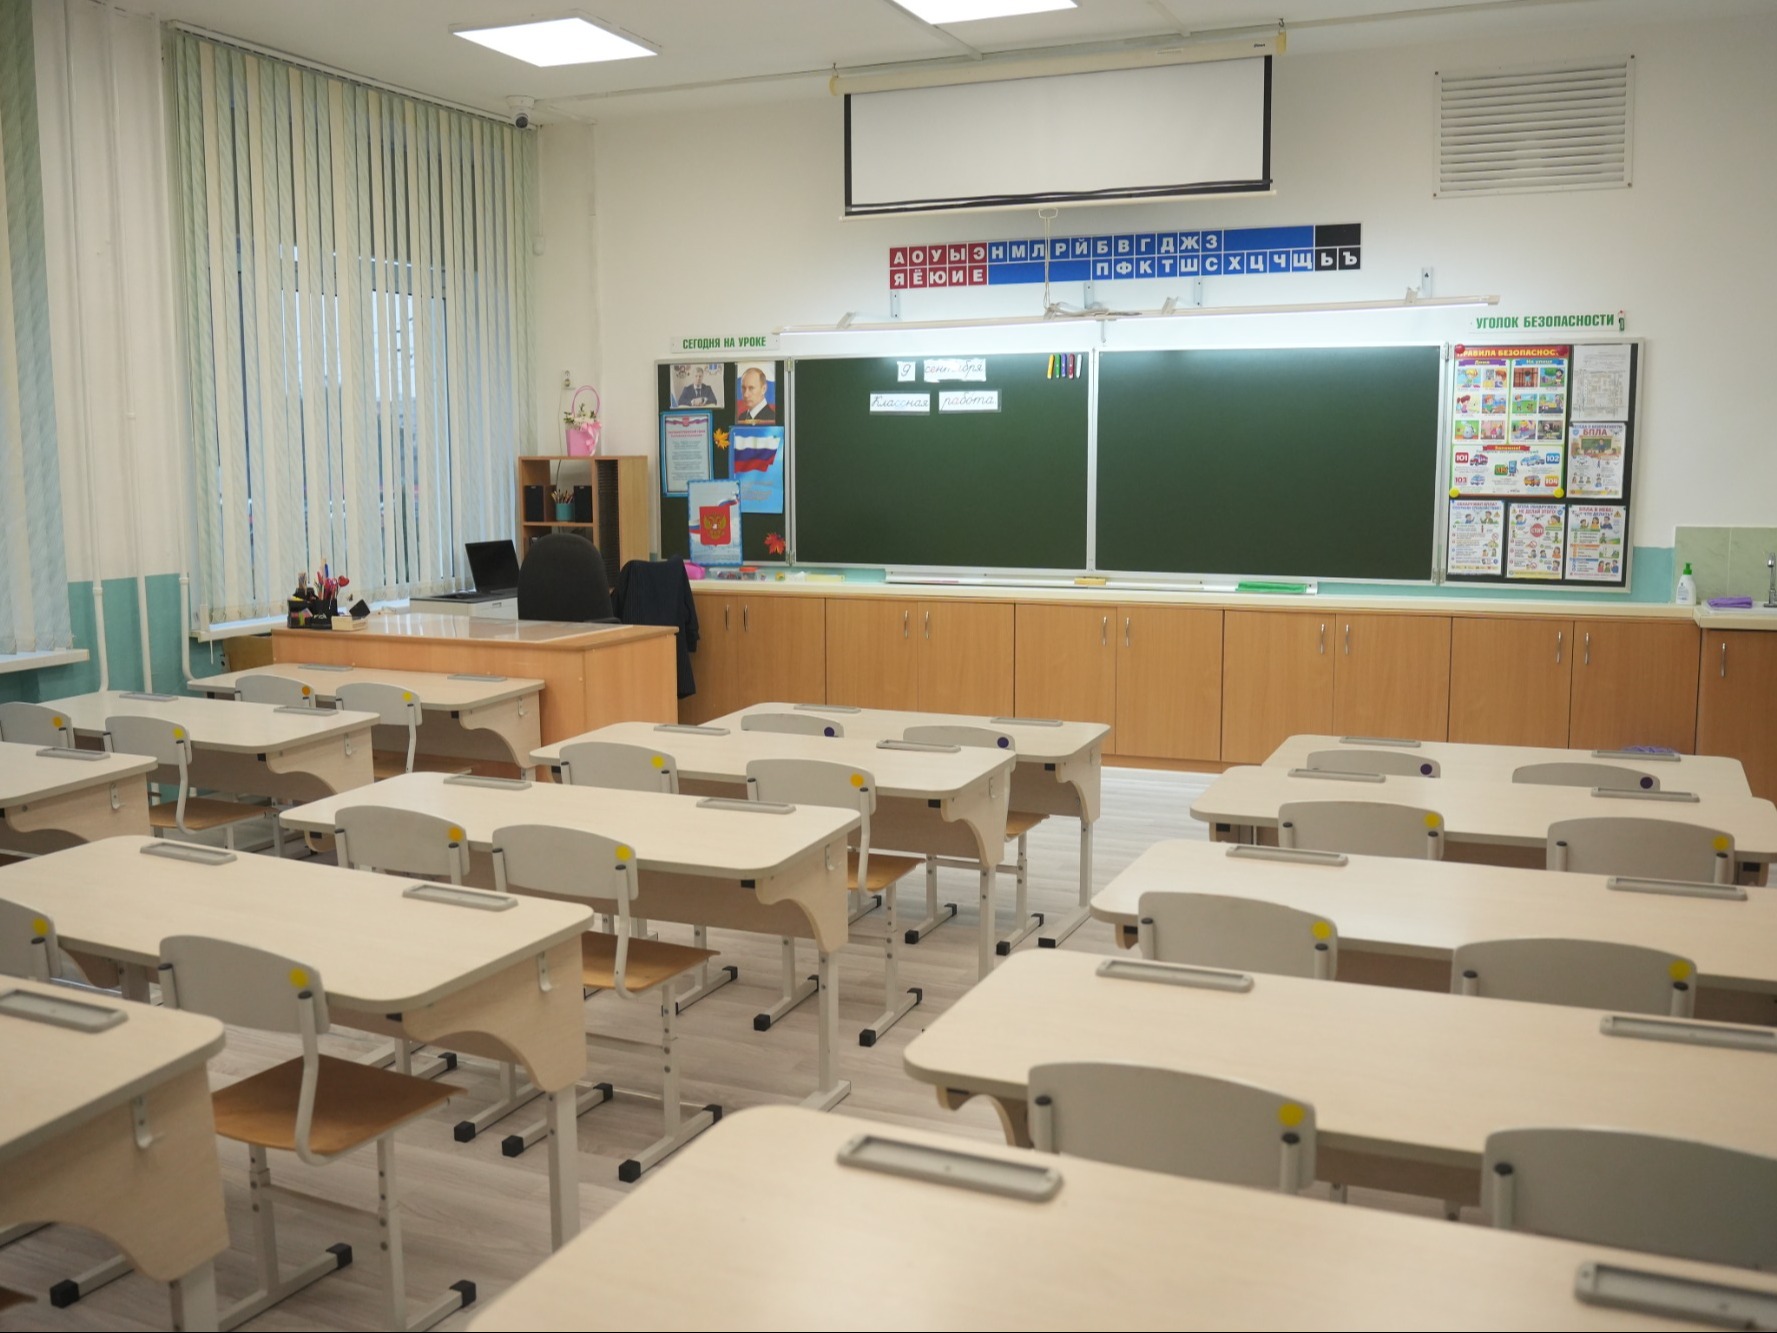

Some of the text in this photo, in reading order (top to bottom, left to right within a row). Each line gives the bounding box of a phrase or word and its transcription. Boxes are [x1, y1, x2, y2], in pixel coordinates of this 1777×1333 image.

[894, 235, 1217, 264] А О У Ы Э Н М Л Р Й Б В Г Д Ж З
[894, 252, 1357, 285] Я Ё Ю И Е П Ф К Т Ш С Х Ц Ч Щ Ь Ъ
[1476, 314, 1614, 329] УГОЛОК БЕЗОПАСНОСТИ
[682, 336, 767, 350] СЕГОДНЯ НА УРОКЕ
[900, 364, 912, 377] 9
[871, 394, 929, 408] Классная
[1546, 455, 1560, 463] 102
[1455, 476, 1467, 484] 103
